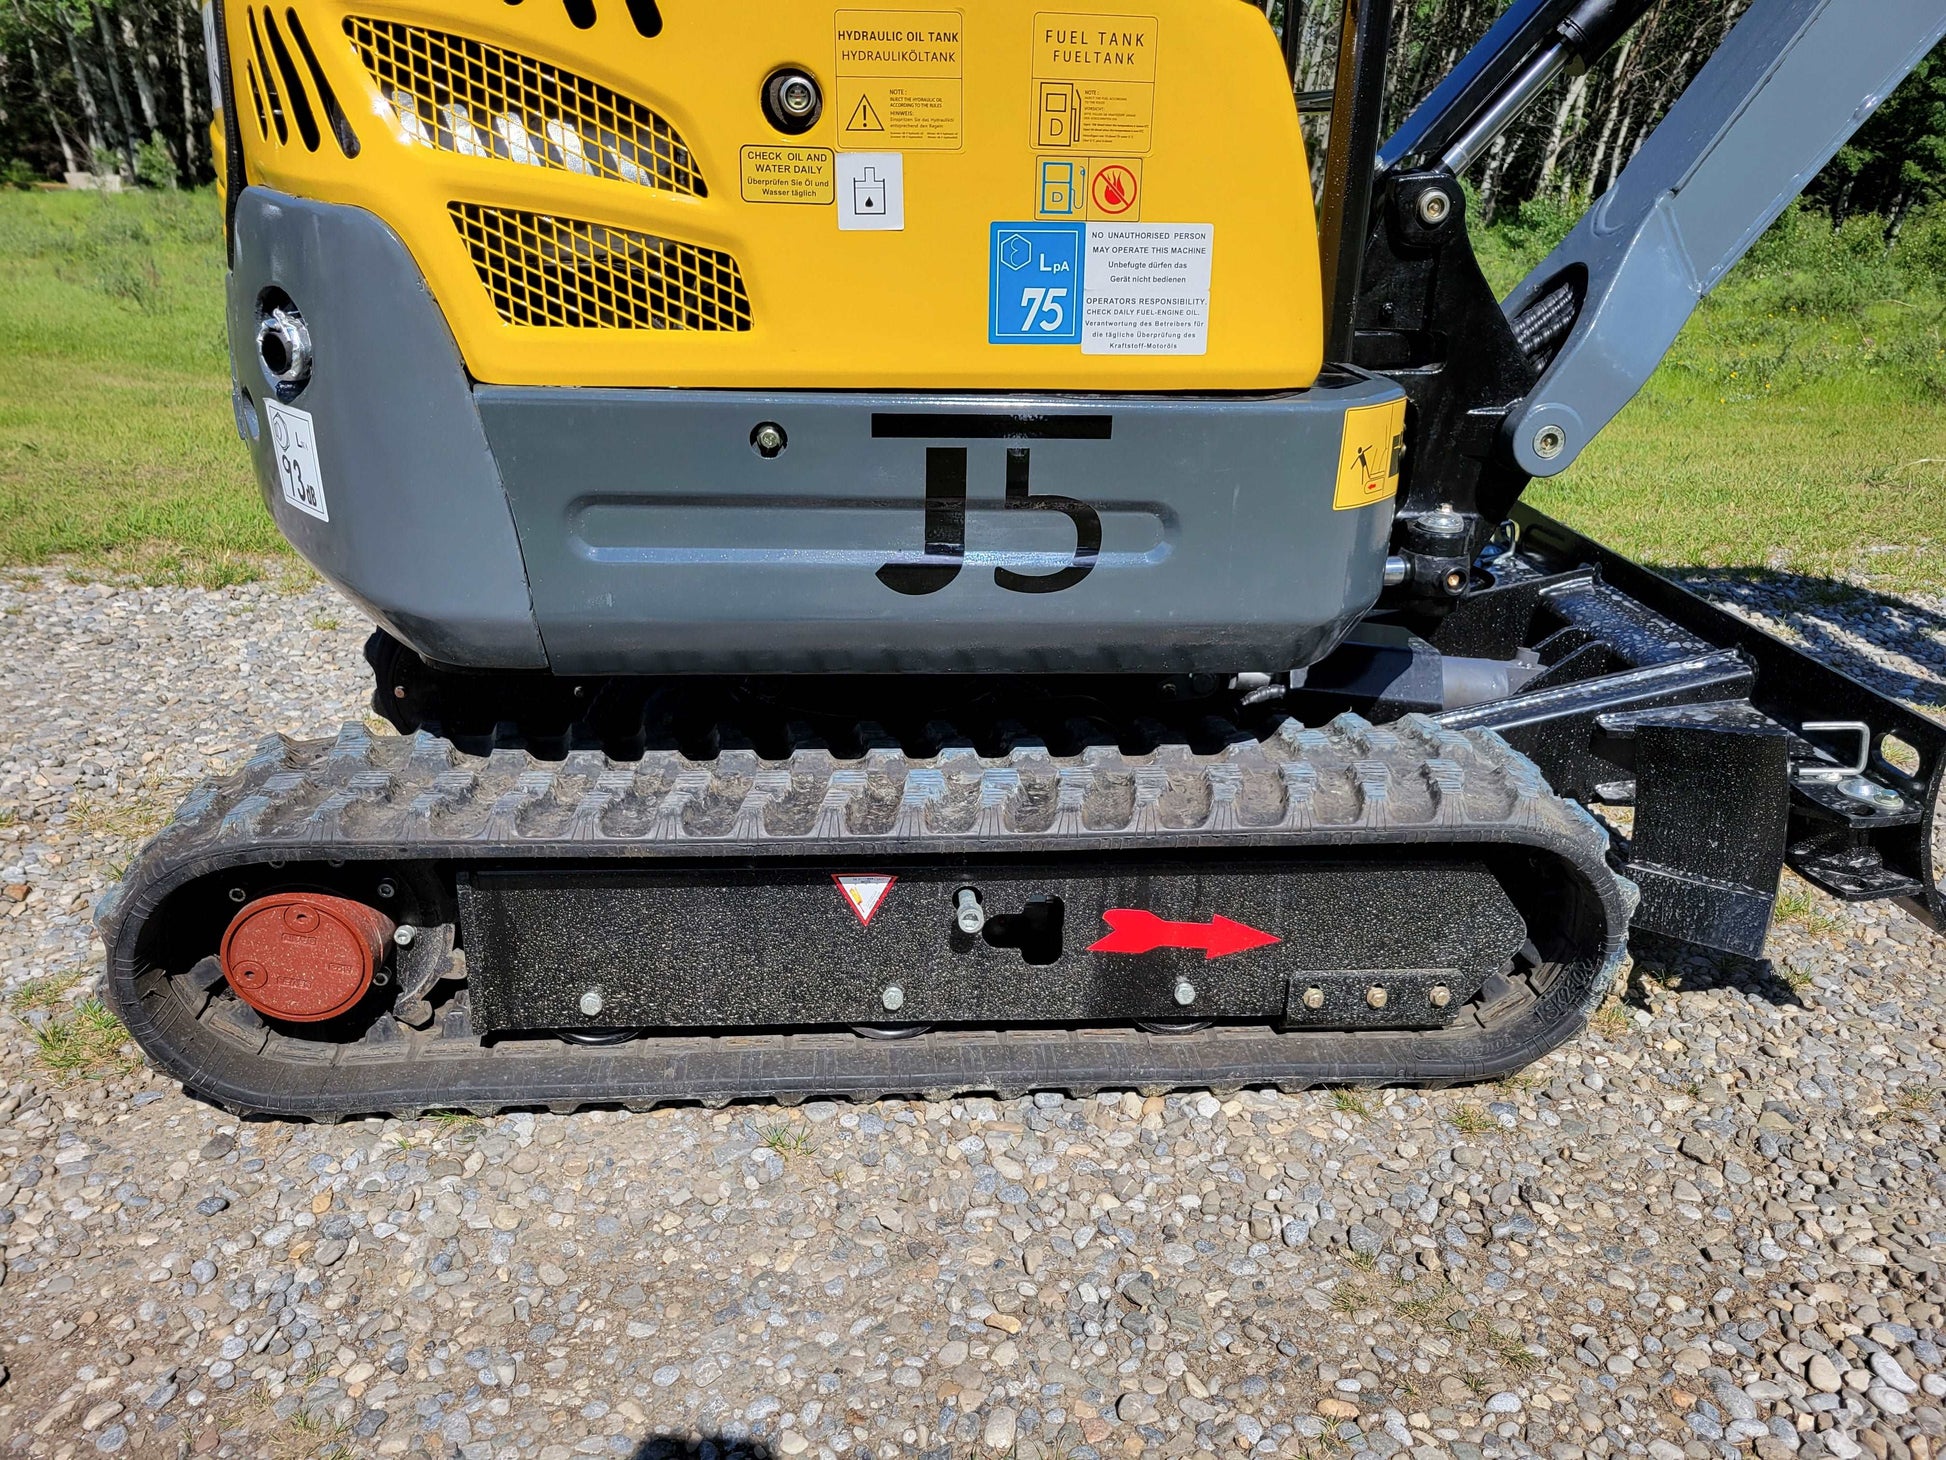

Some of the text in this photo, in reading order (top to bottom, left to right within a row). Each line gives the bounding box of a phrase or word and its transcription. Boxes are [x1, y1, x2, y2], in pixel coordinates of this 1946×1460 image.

[838, 30, 959, 42] HYDRAULIC OIL TANK
[1045, 29, 1144, 47] FUEL TANK
[842, 49, 955, 62] HYDRAULIKÖLTANK
[1053, 50, 1134, 64] FUELTANK
[1050, 118, 1064, 136] D
[748, 151, 827, 162] CHECK OIL AND
[755, 164, 822, 174] WATER DAILY
[747, 176, 788, 186] Überprüfen
[1108, 261, 1146, 269] Unbefugte
[1020, 288, 1068, 332] 75
